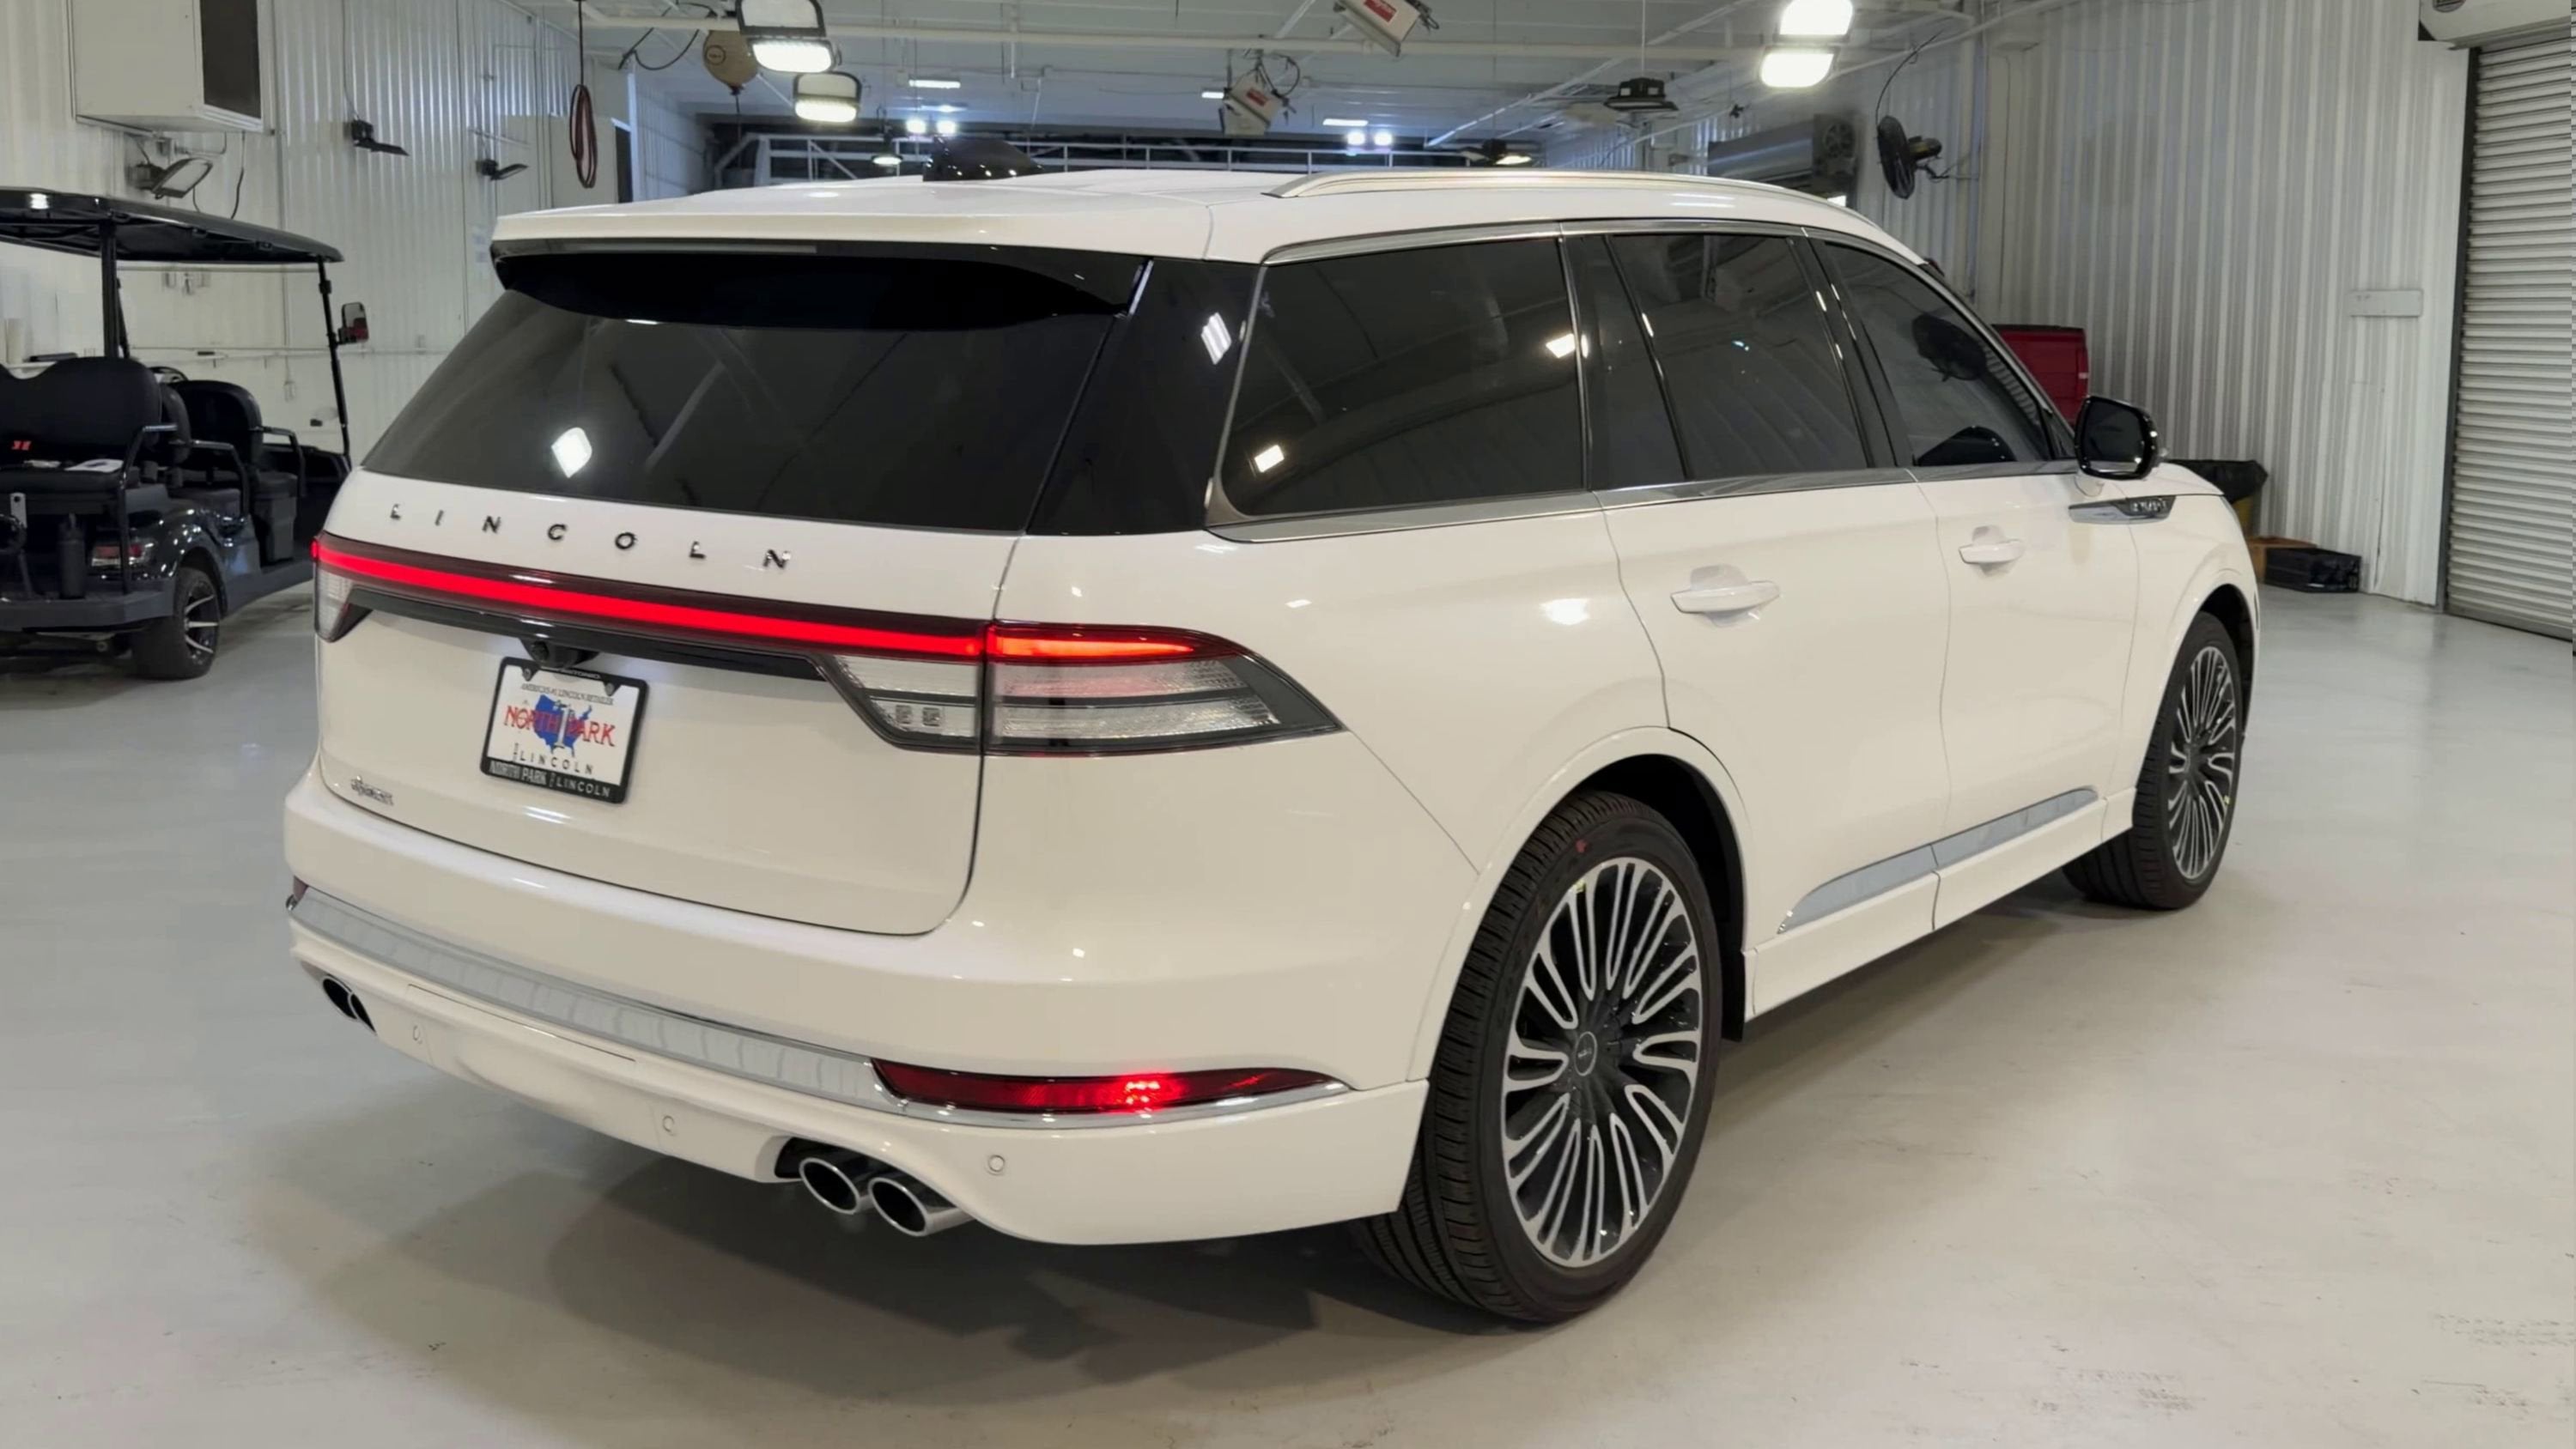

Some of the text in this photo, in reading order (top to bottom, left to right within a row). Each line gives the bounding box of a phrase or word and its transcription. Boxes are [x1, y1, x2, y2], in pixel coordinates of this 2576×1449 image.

[389, 503, 793, 570] LINCOLN
[503, 706, 616, 748] NORTH PARK
[519, 750, 594, 775] LINCOLN
[521, 766, 547, 785] PARK
[556, 775, 611, 798] LINCOLN
